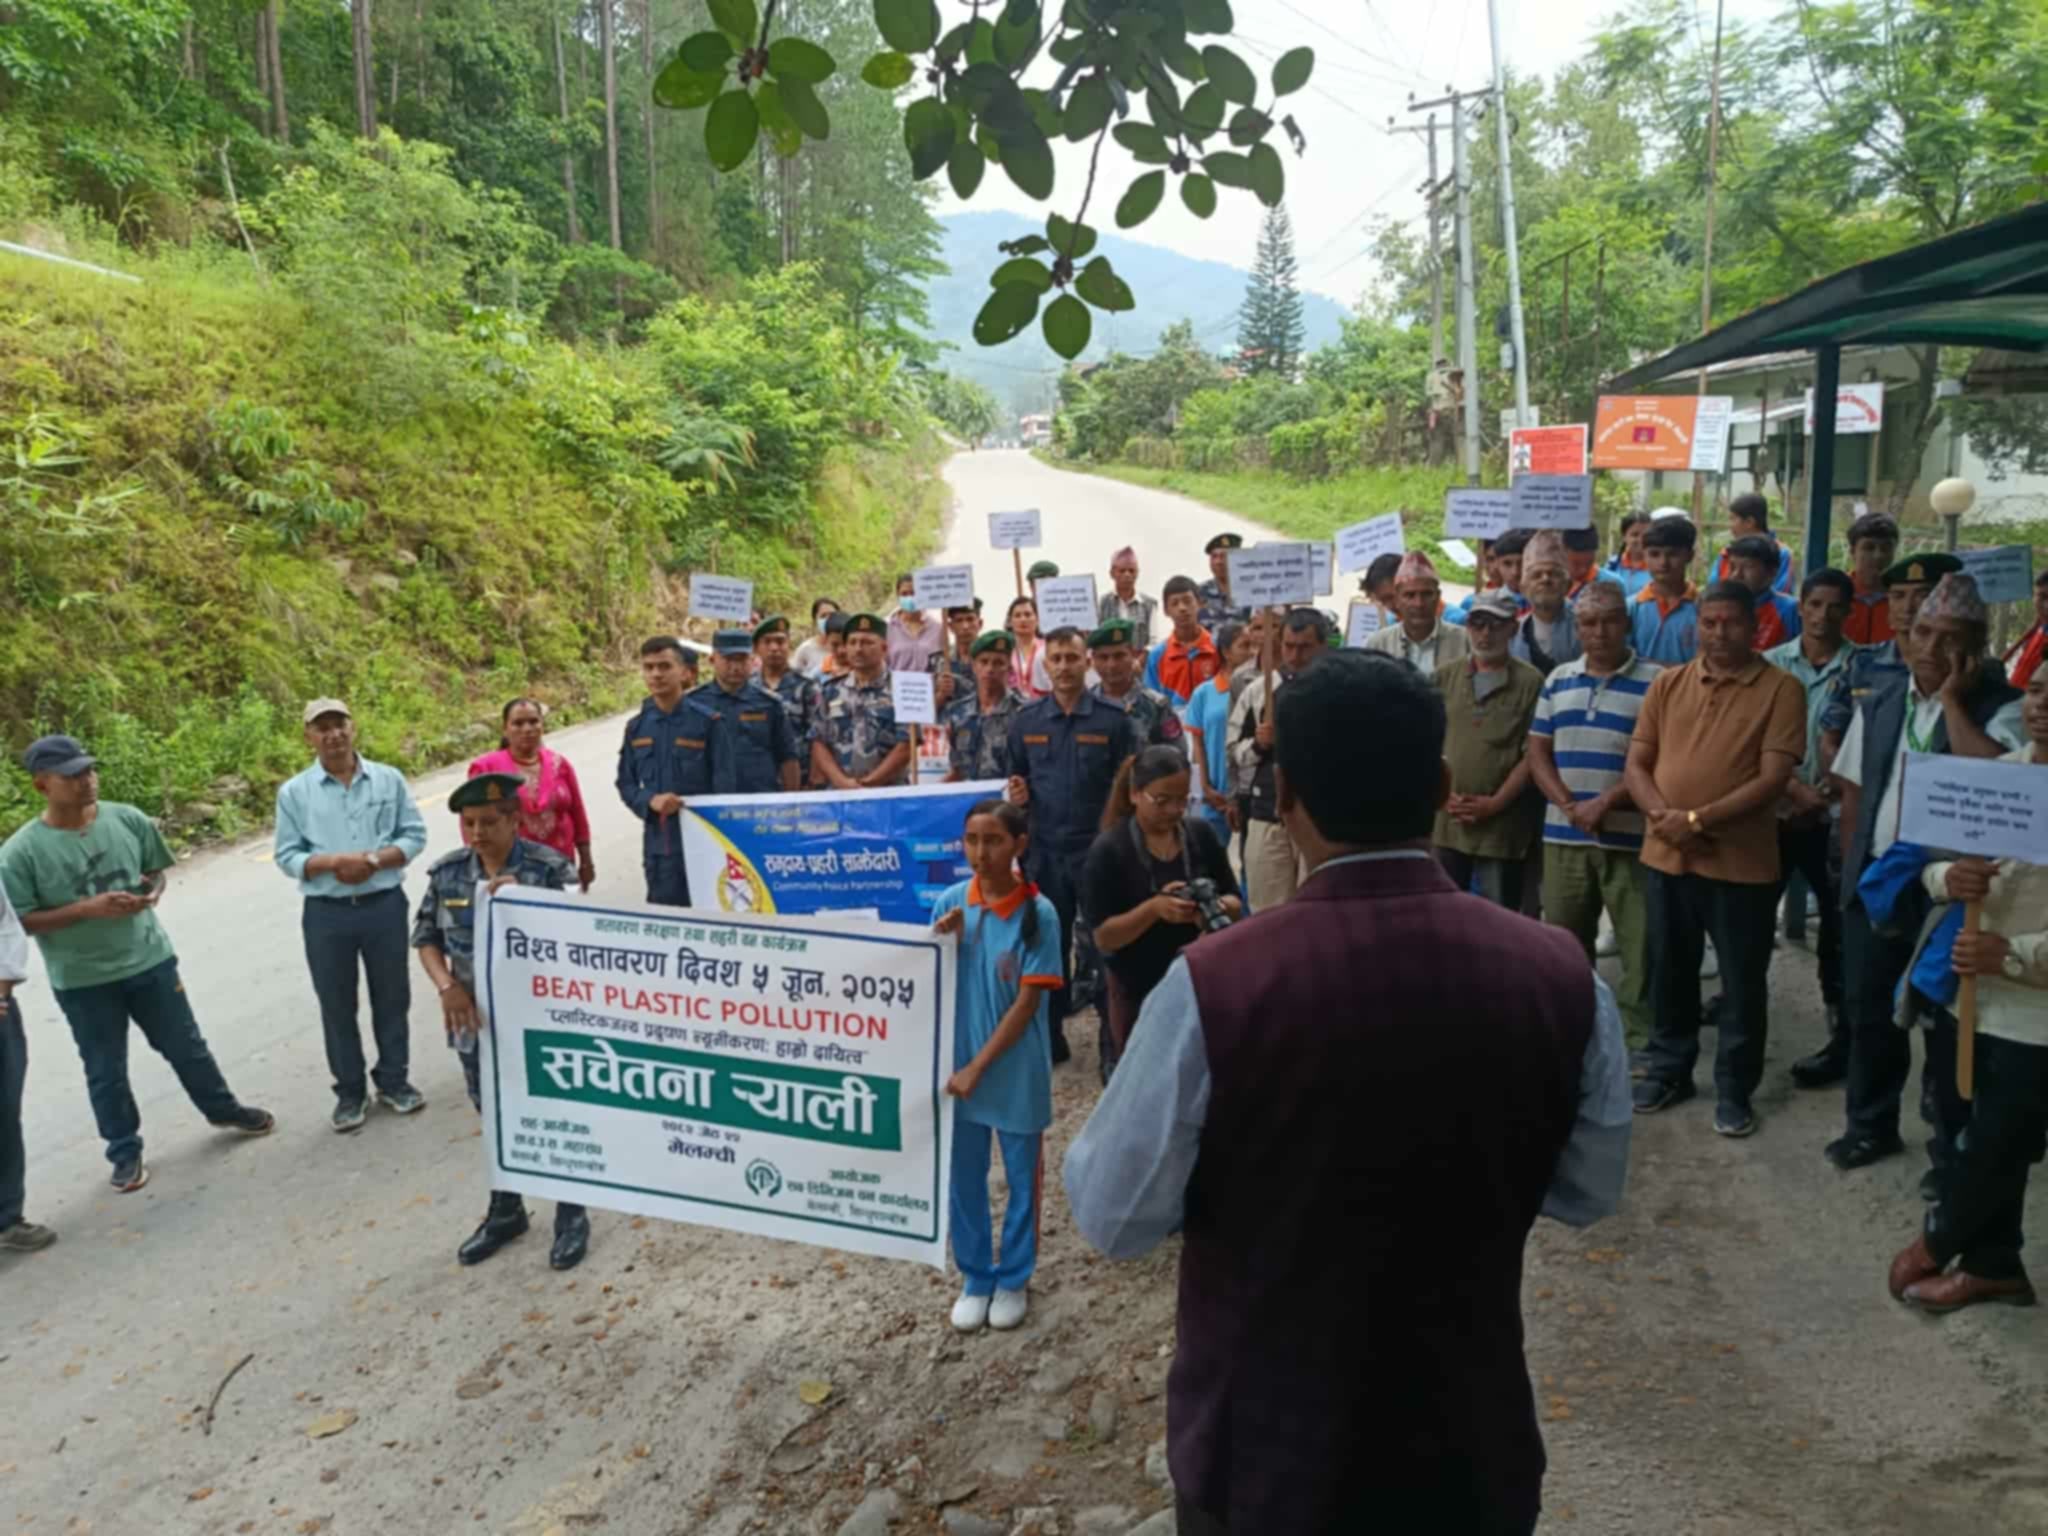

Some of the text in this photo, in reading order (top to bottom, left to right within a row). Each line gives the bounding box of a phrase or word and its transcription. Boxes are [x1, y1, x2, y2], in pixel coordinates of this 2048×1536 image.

[772, 880, 822, 892] Community
[850, 879, 904, 892] Partnership
[594, 917, 640, 937] वातावरण
[684, 927, 706, 942] तथा
[761, 934, 809, 952] कार्यक्रम
[504, 927, 558, 963] विश्व
[566, 942, 668, 978] वातावरण
[677, 947, 742, 988] दिवश
[752, 963, 769, 995] ५
[842, 973, 915, 1009] २०२५
[531, 975, 888, 1041] BEAT PLASTIC POLLUTION
[776, 1038, 809, 1059] हाम्रो
[540, 1038, 716, 1109] सचेतना
[668, 1137, 737, 1164] मेलम्ची
[878, 1191, 930, 1213] कार्यालय
